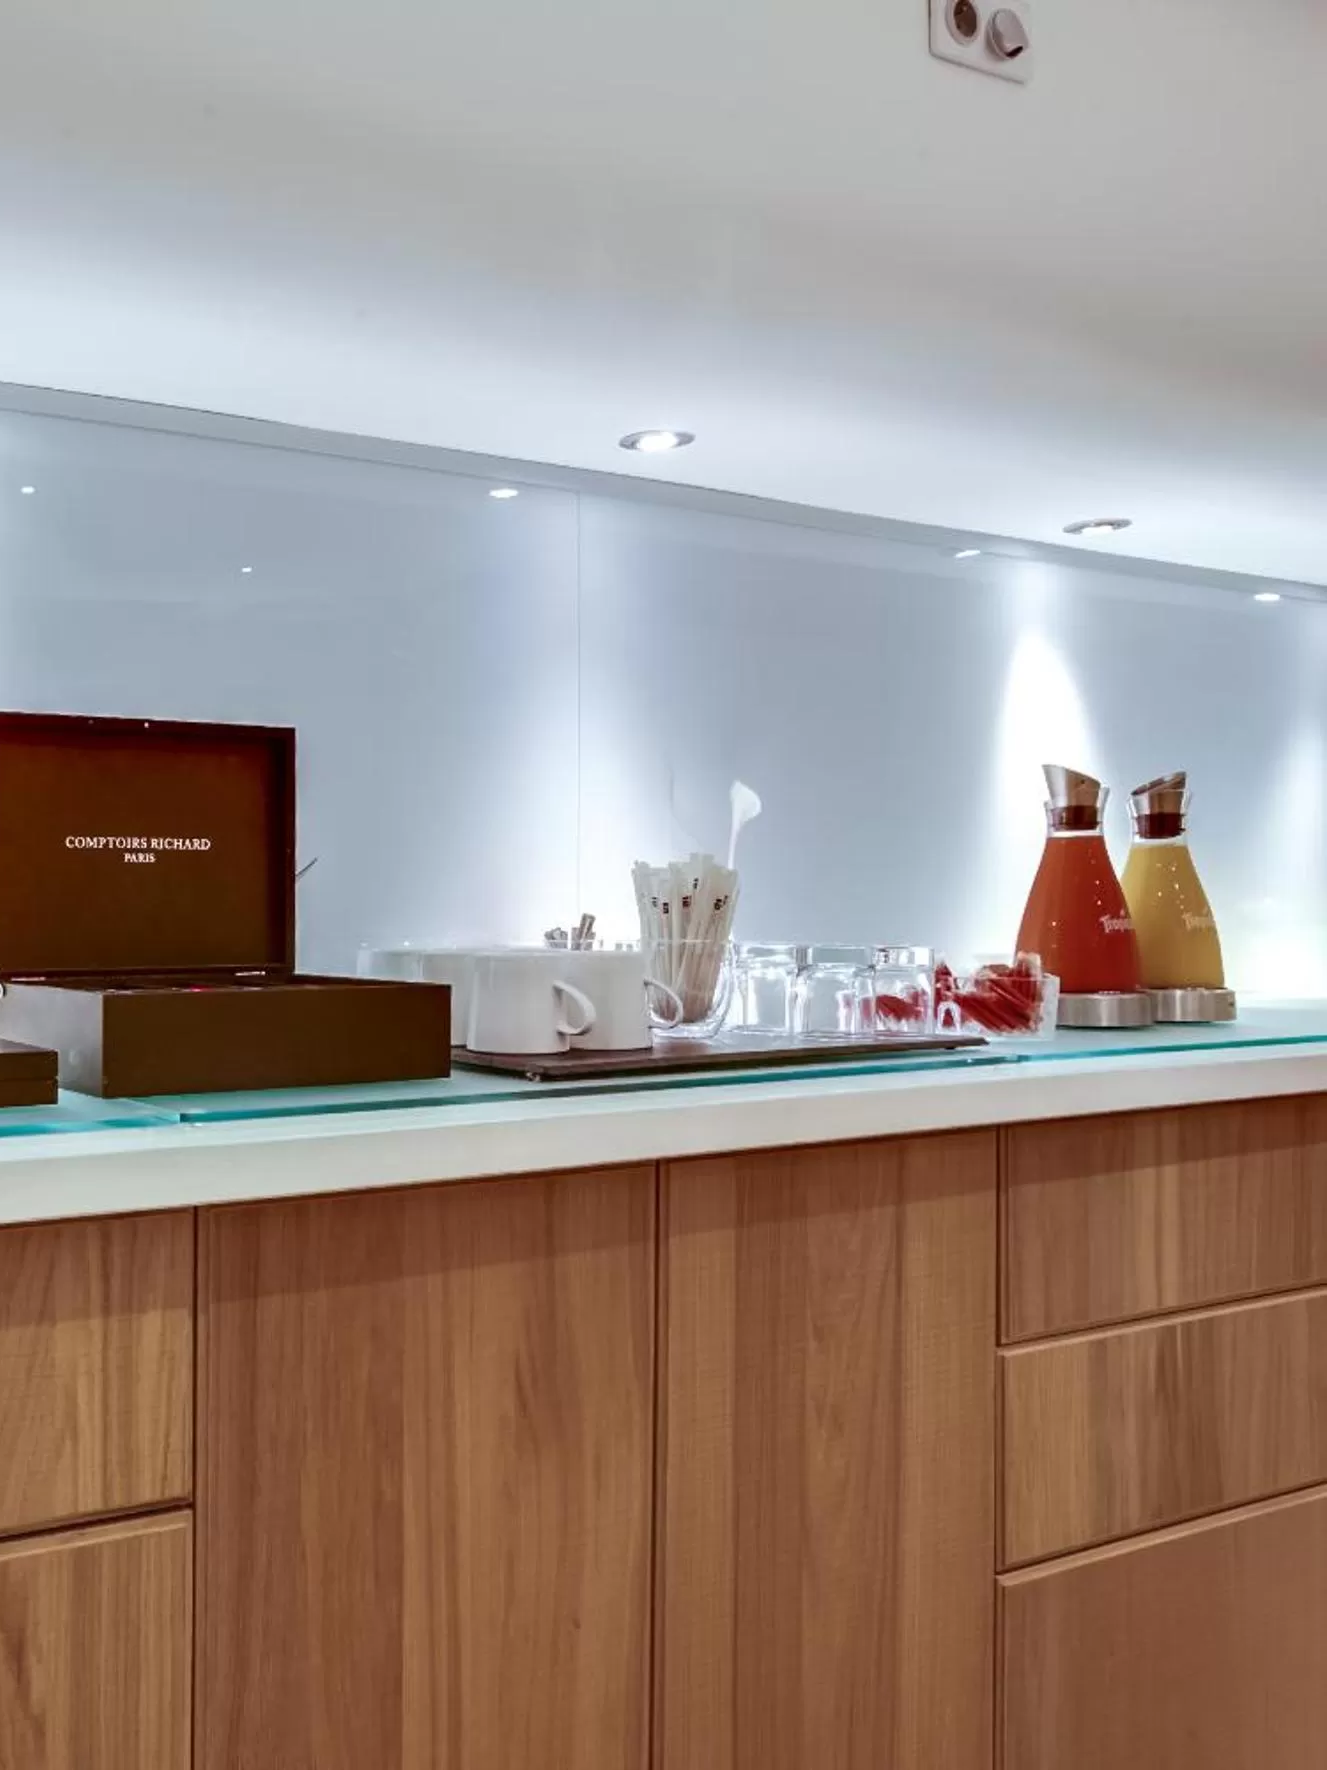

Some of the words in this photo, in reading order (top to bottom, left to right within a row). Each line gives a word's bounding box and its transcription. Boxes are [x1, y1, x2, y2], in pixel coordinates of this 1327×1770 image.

[65, 836, 147, 849] COMPTOIRS
[150, 838, 211, 850] RICHARD
[124, 852, 156, 863] PARIS
